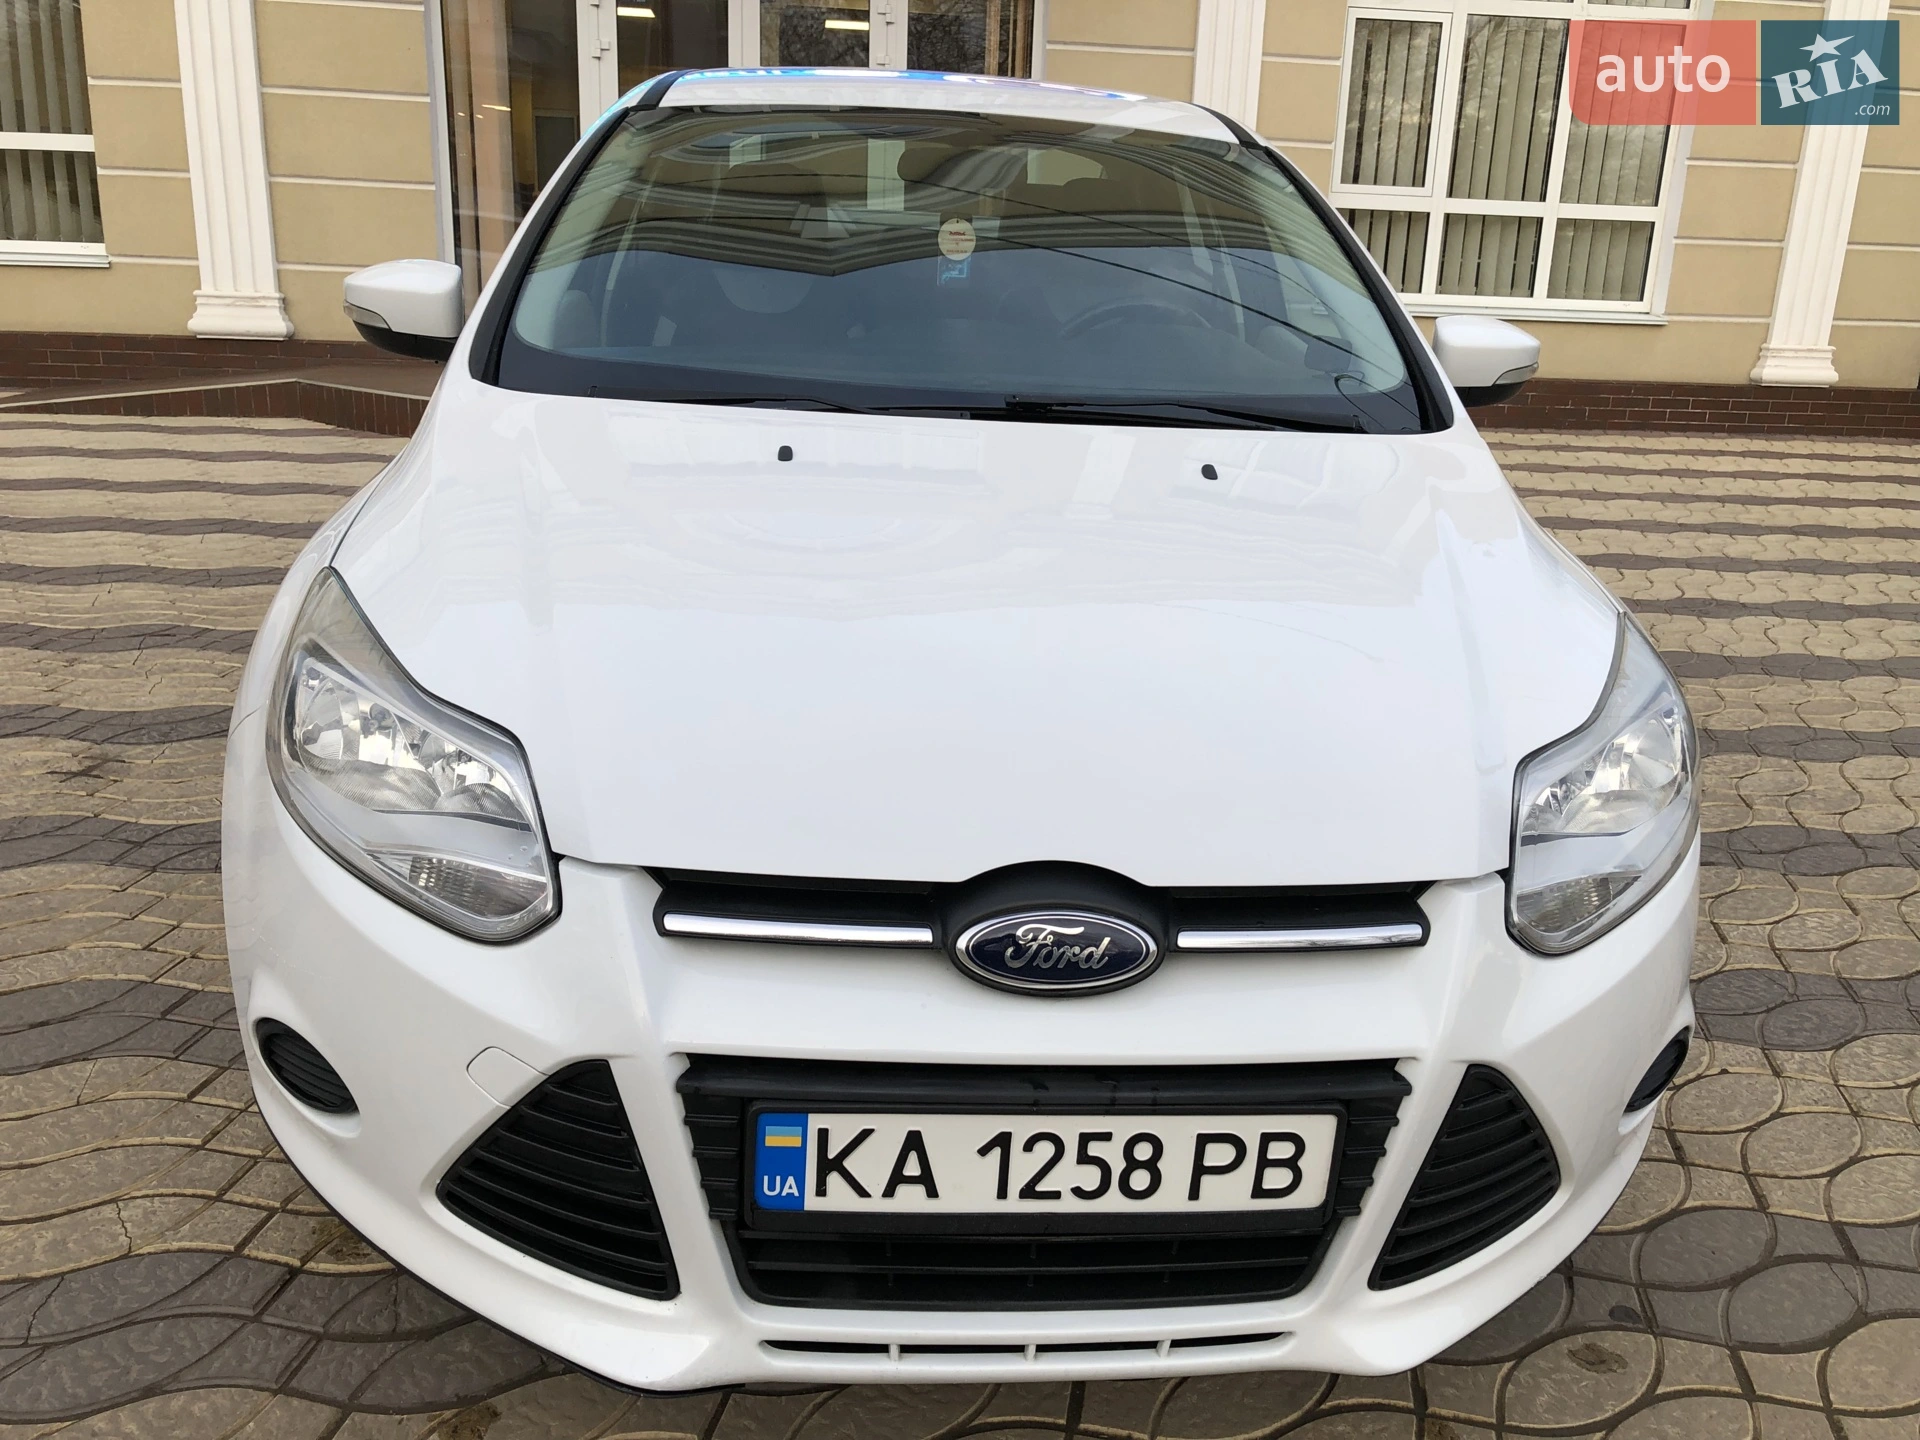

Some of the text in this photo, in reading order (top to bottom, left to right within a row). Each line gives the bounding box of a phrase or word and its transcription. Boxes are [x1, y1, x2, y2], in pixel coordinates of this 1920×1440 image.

[1004, 923, 1112, 969] Ford
[762, 1175, 801, 1197] UA
[815, 1126, 1307, 1201] KA 1258 PB
